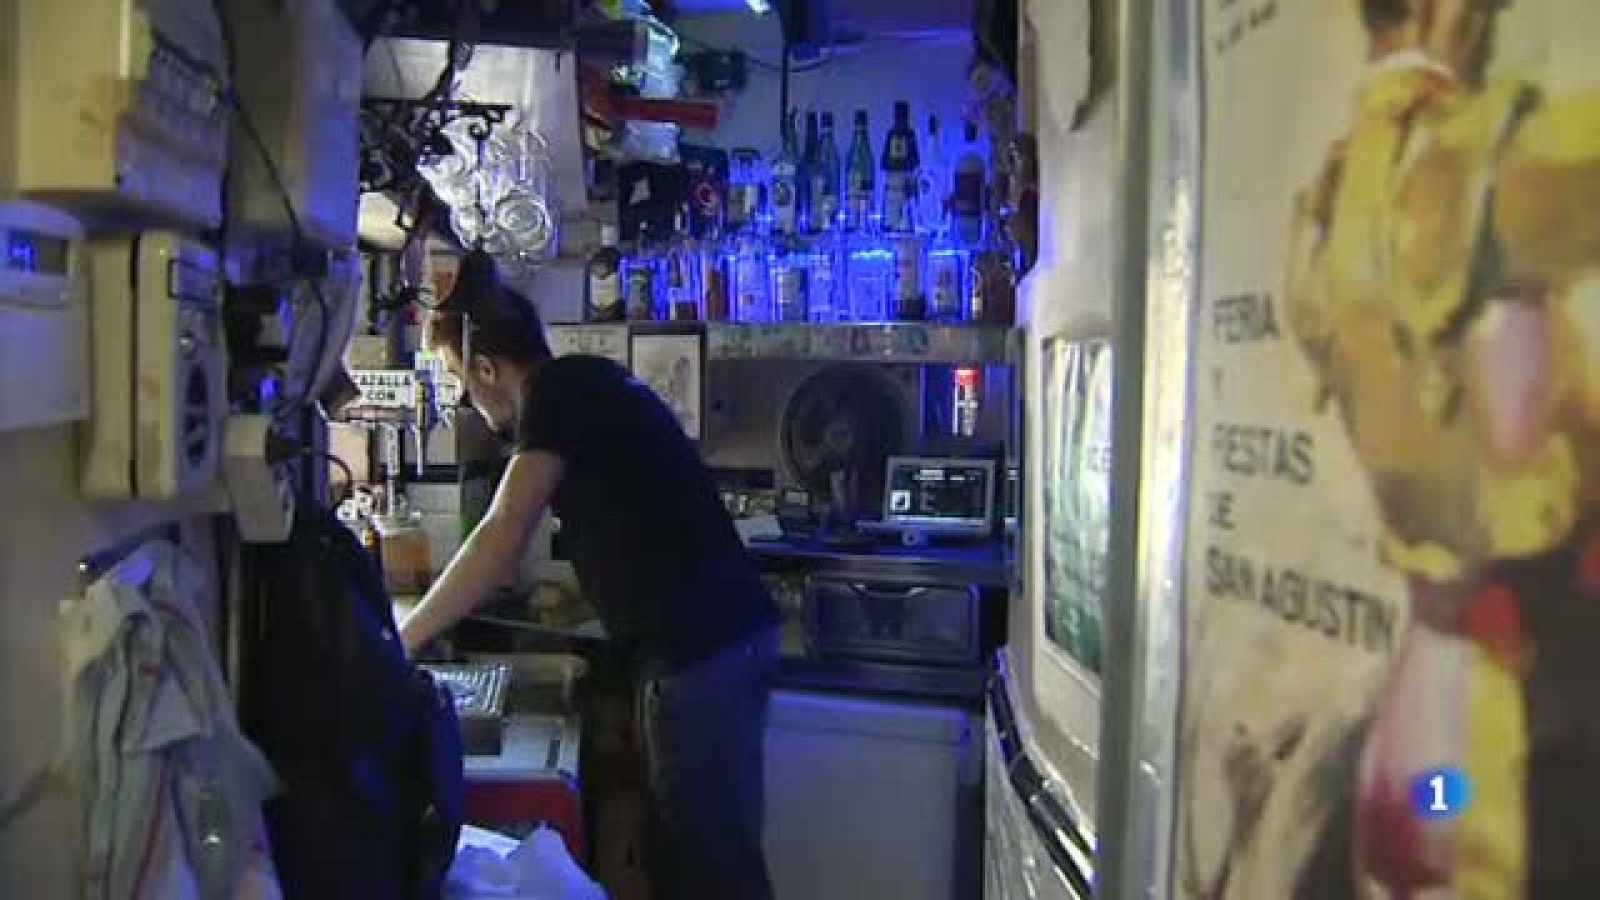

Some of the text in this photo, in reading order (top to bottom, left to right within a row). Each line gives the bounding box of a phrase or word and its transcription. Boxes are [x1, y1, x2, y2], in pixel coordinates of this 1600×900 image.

[1210, 293, 1280, 344] FERIA
[366, 388, 396, 401] CON
[1210, 423, 1314, 486] FESTAS
[1204, 545, 1253, 601] SAN
